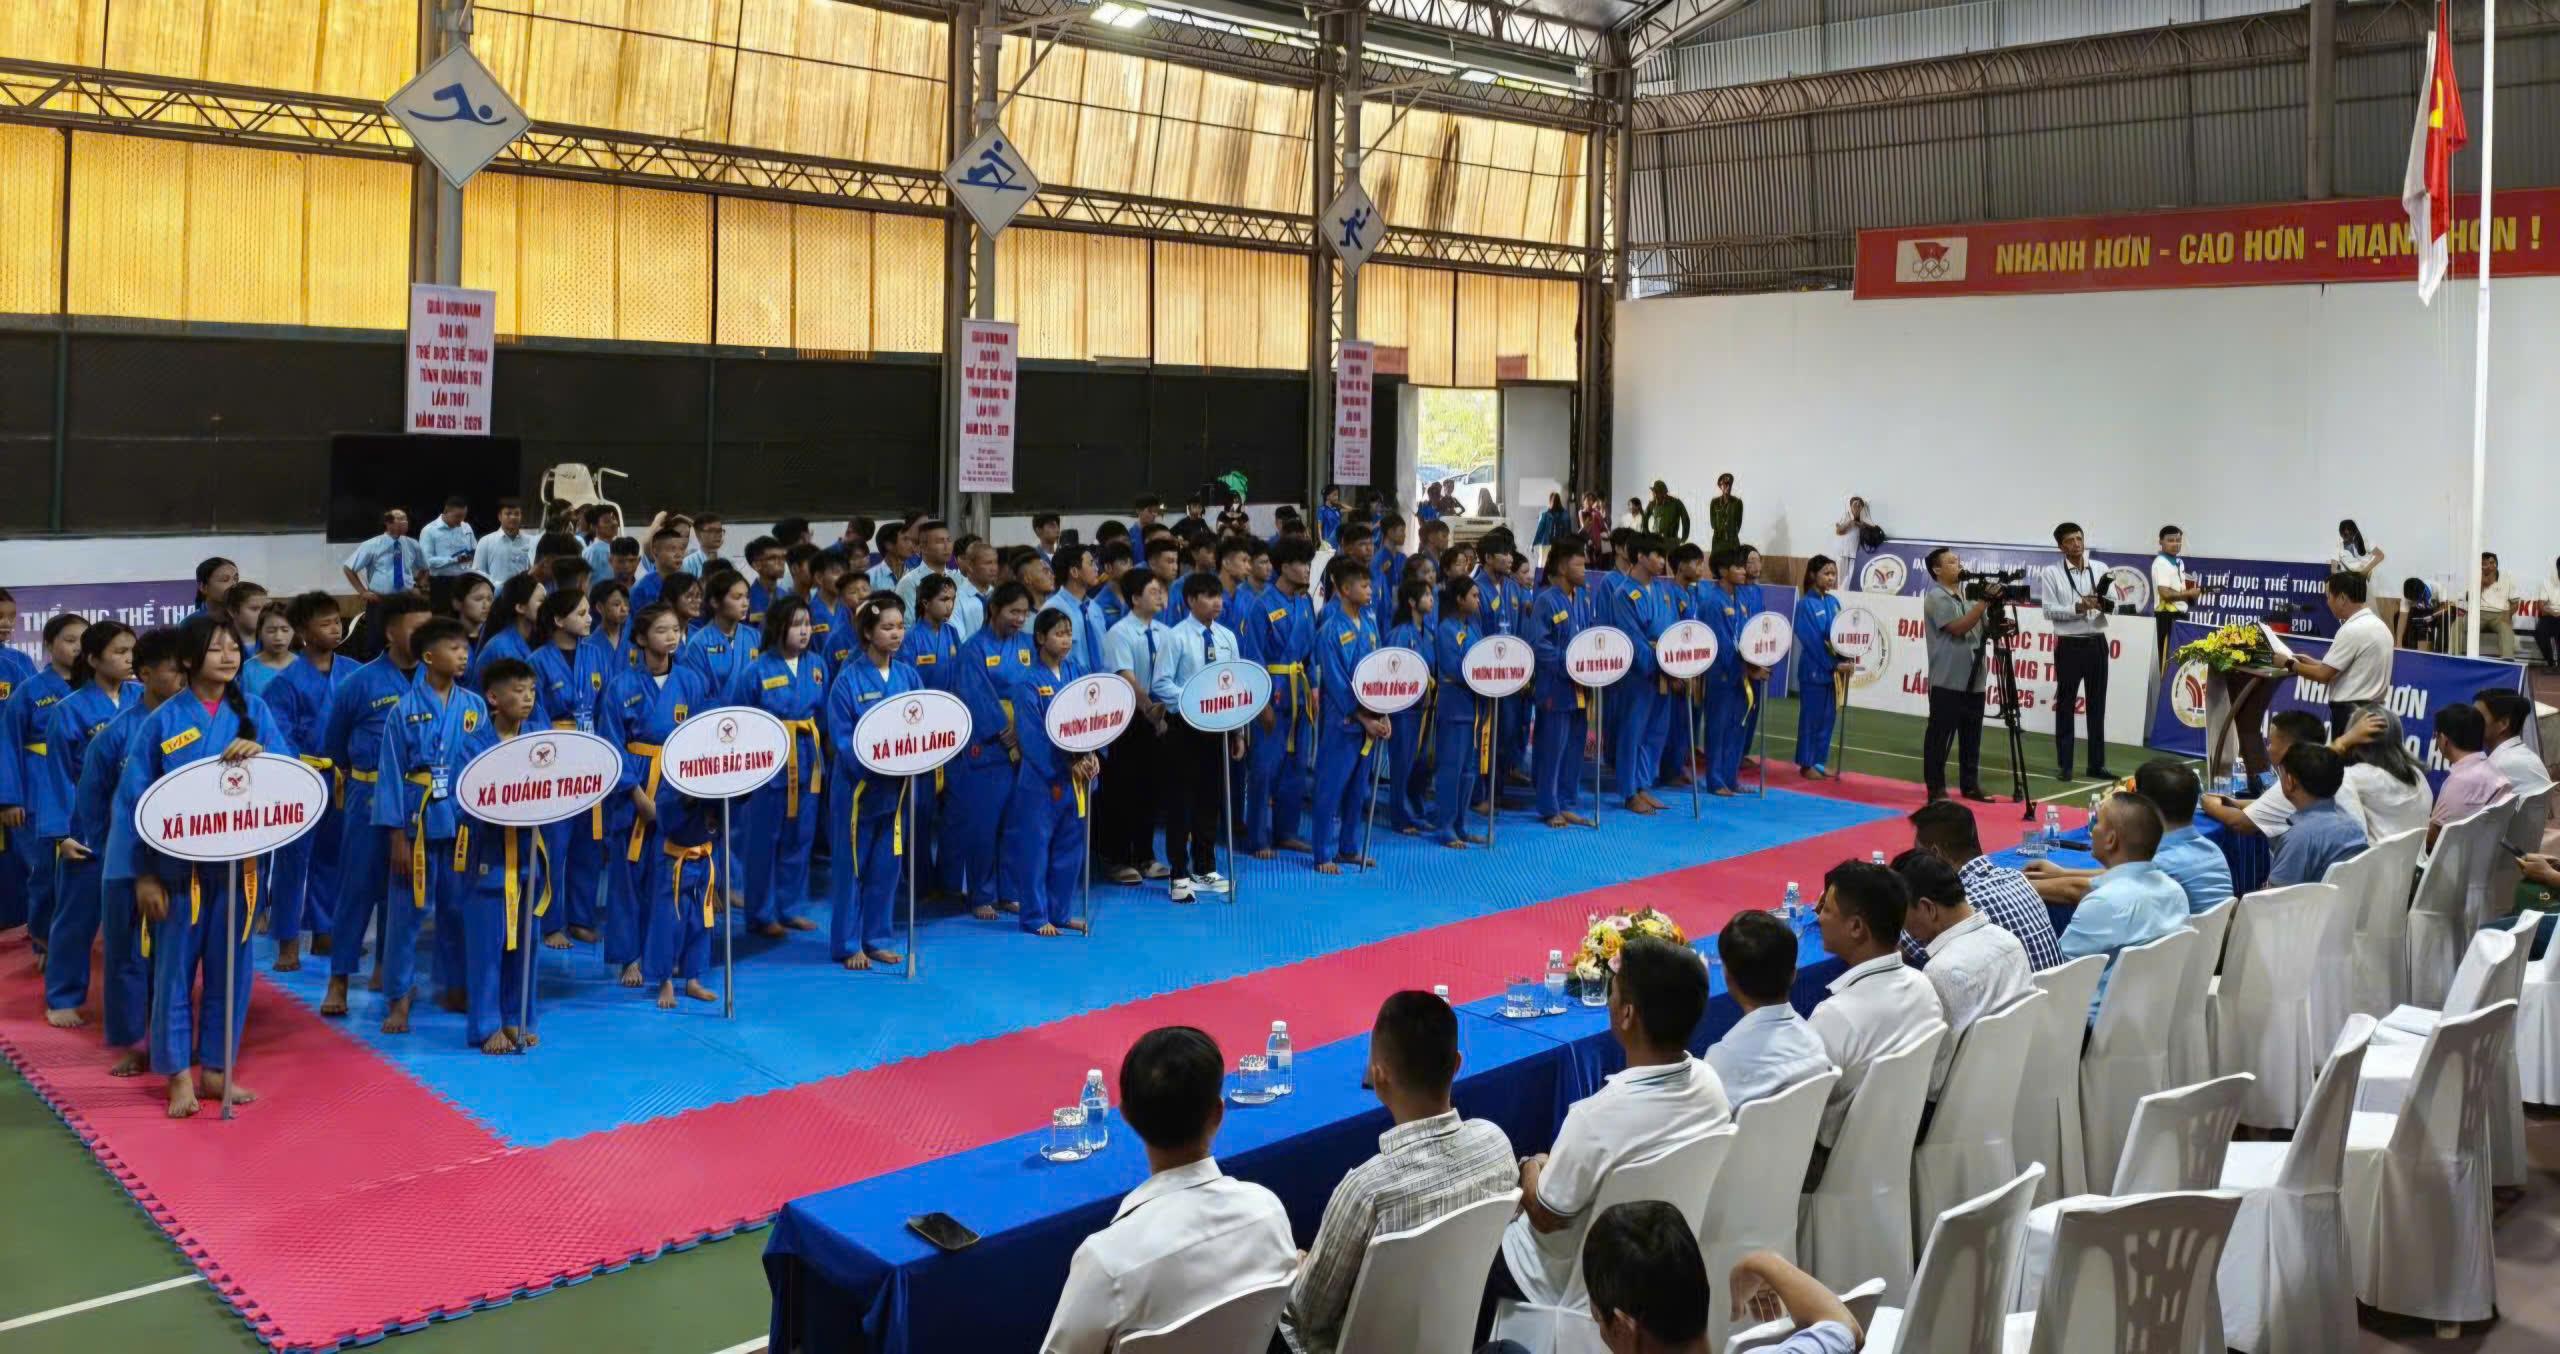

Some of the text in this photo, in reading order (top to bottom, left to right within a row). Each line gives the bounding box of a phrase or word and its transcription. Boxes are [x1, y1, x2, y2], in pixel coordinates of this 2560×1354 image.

[1996, 239, 2086, 274] NHANH
[2094, 234, 2150, 269] HƠN
[2179, 231, 2235, 265] CAO
[2244, 224, 2304, 262] HƠN
[2337, 223, 2419, 264] MẠN
[117, 600, 155, 626] THỂ
[873, 730, 956, 760] XÃ HẢI LĂNG
[477, 781, 497, 807] XÃ
[557, 774, 602, 799] TRẠCH
[162, 801, 304, 840] XÃ NAM HẢI LĂNG
